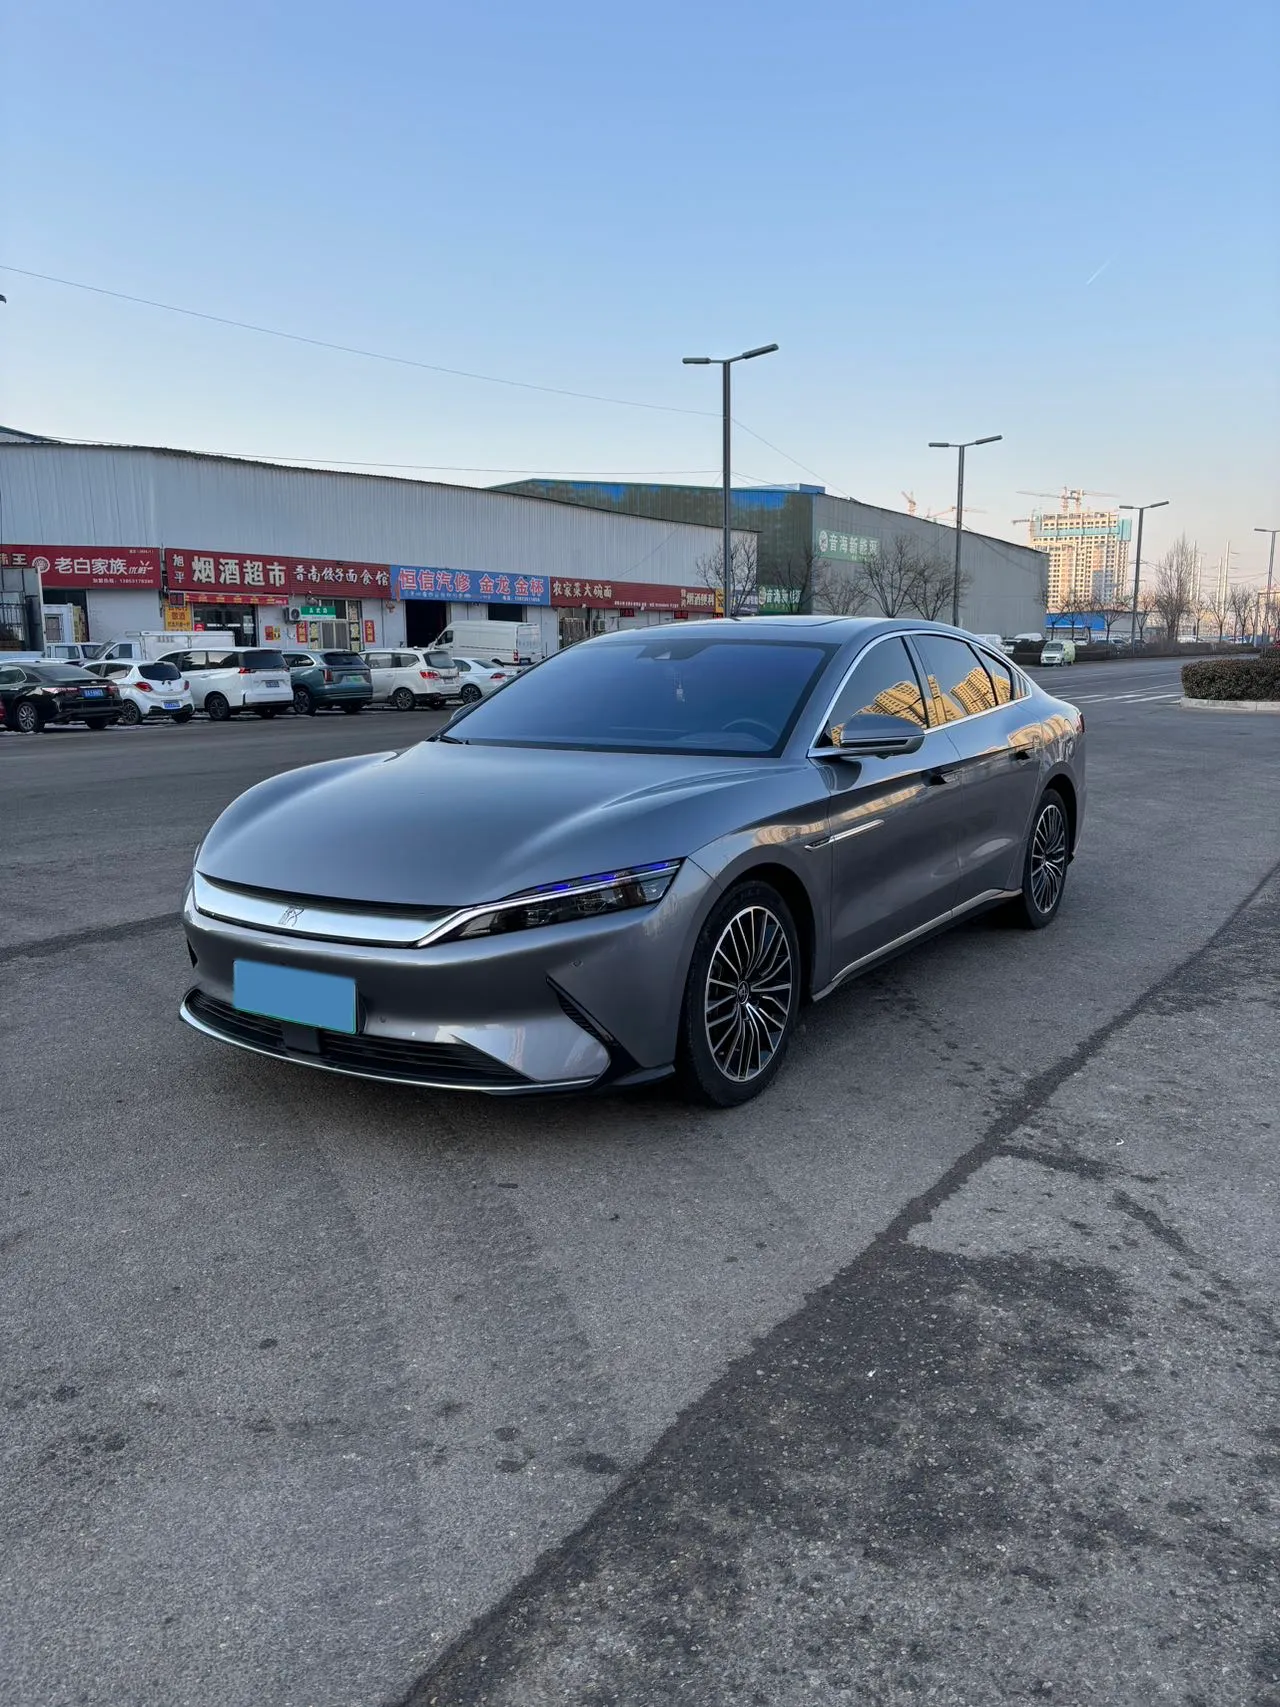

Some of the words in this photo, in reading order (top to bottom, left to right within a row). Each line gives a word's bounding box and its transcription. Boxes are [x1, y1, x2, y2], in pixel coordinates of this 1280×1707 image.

[55, 557, 128, 576] 老白家族
[172, 553, 186, 583] 旭平
[192, 556, 287, 588] 烟酒超市
[398, 567, 470, 593] 恒信汽修
[552, 580, 612, 598] 农家菜大碗面
